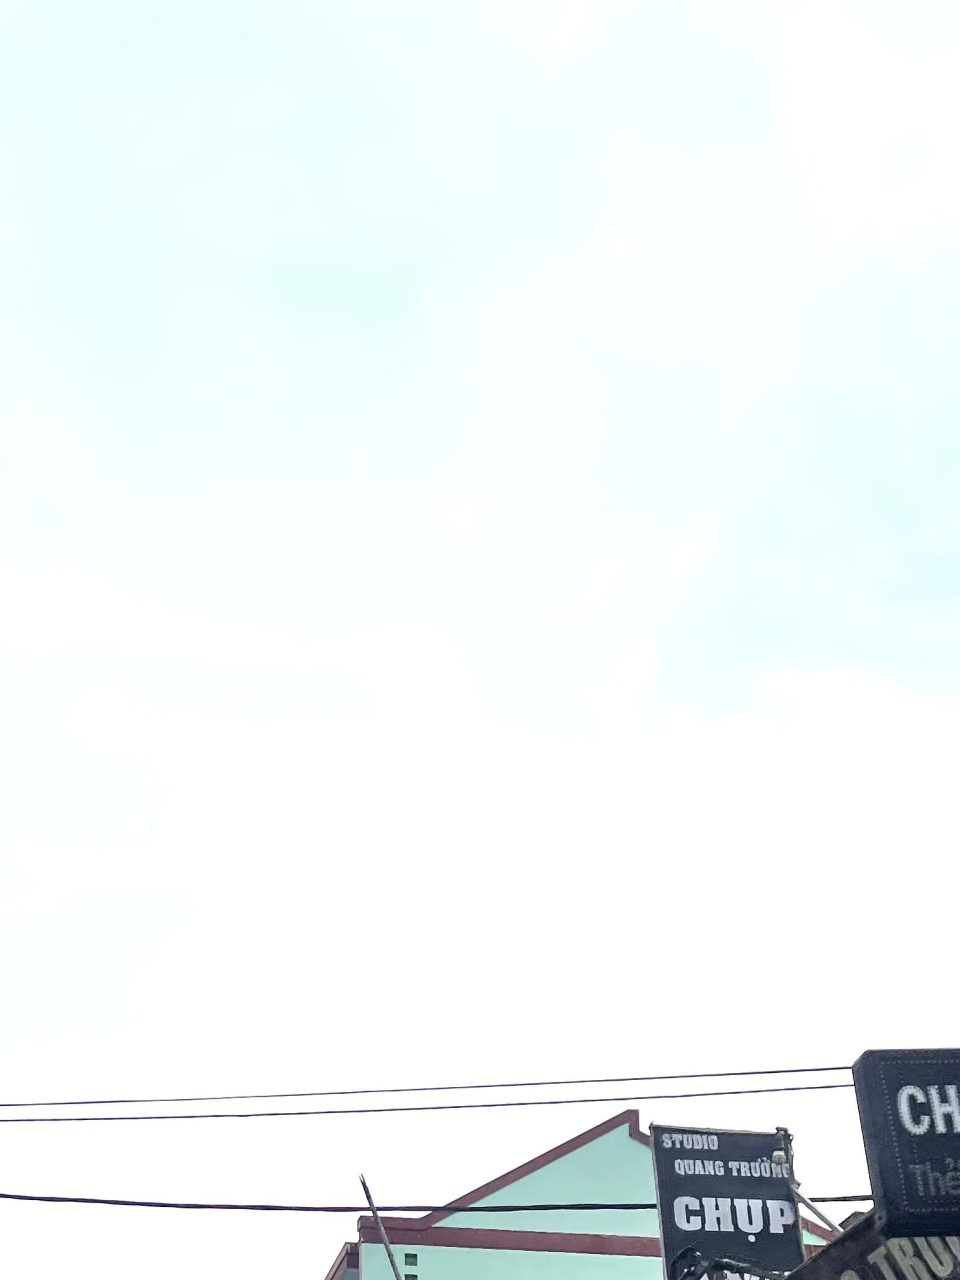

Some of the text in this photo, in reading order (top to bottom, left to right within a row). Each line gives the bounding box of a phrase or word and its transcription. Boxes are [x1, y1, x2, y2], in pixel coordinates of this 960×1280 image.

[662, 1133, 719, 1150] STUDIO
[674, 1159, 725, 1176] QUANG
[673, 1196, 796, 1242] CHỤP
